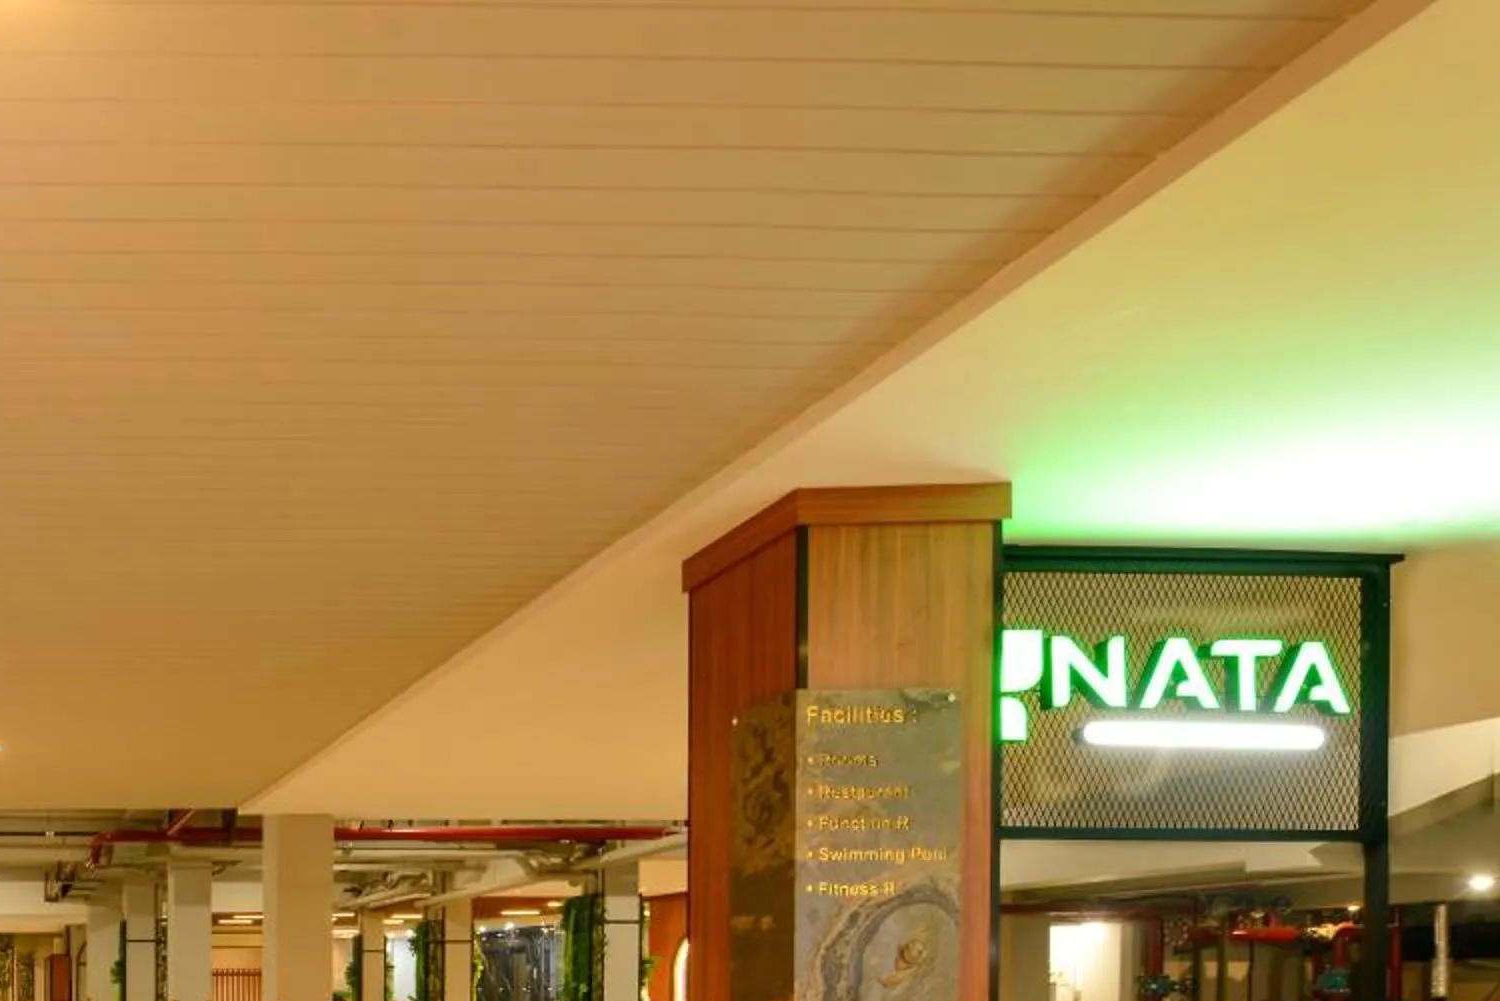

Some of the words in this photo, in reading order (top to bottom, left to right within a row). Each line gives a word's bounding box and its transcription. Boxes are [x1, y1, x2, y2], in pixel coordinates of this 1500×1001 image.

[806, 705, 905, 724] Facilities
[818, 847, 905, 865] Swimming
[818, 881, 878, 897] Fitness
